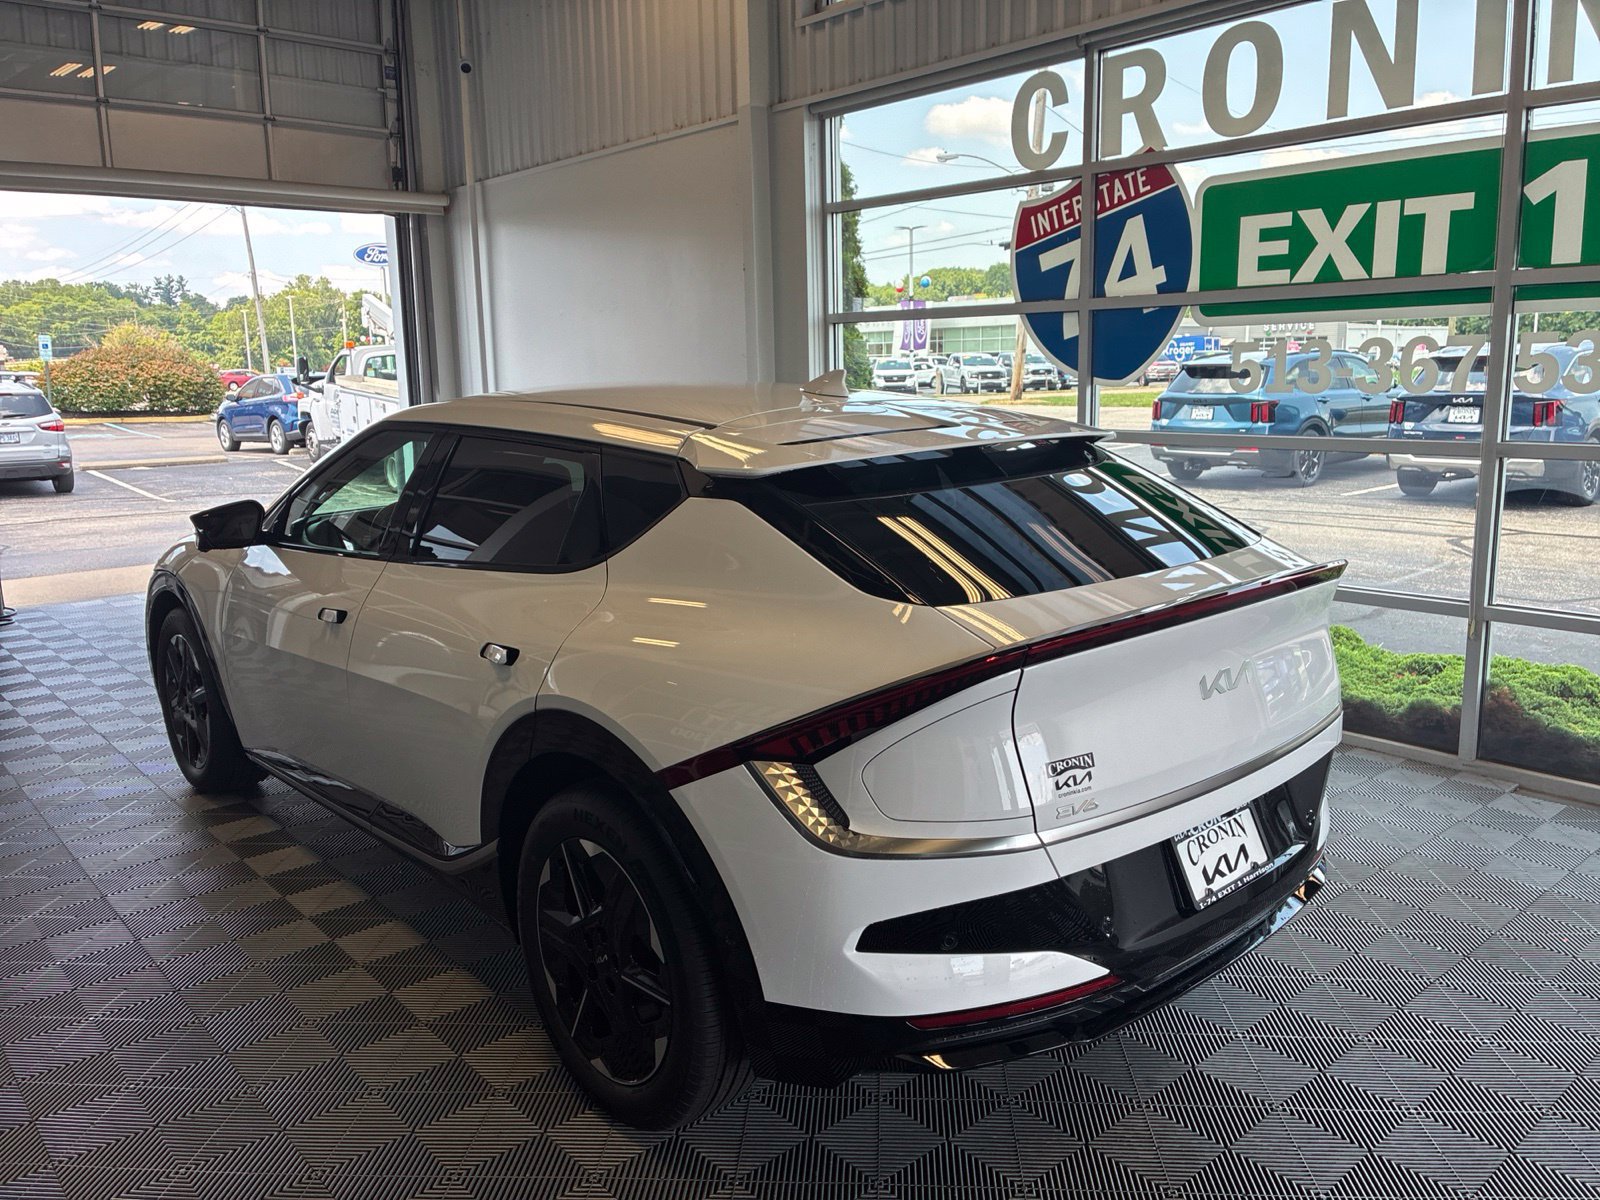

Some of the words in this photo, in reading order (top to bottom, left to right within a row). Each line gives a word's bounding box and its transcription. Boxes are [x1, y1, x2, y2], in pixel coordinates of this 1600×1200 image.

[1030, 167, 1151, 239] INTERTATE
[1236, 191, 1476, 288] EXIT
[1522, 158, 1589, 265] 1
[363, 246, 389, 263] For
[1038, 213, 1167, 341] 74
[1229, 330, 1600, 396] 513-36753
[1199, 659, 1250, 701] KIA
[1048, 753, 1093, 777] CRONIN
[1054, 771, 1093, 791] KIA
[1055, 797, 1099, 819] EV6
[1186, 814, 1249, 867] CRONIN
[1199, 896, 1217, 910] I-74
[1217, 885, 1236, 899] EXIT
[1237, 880, 1243, 888] 1
[1243, 863, 1274, 883] Harrison
[1202, 843, 1250, 887] KIA
